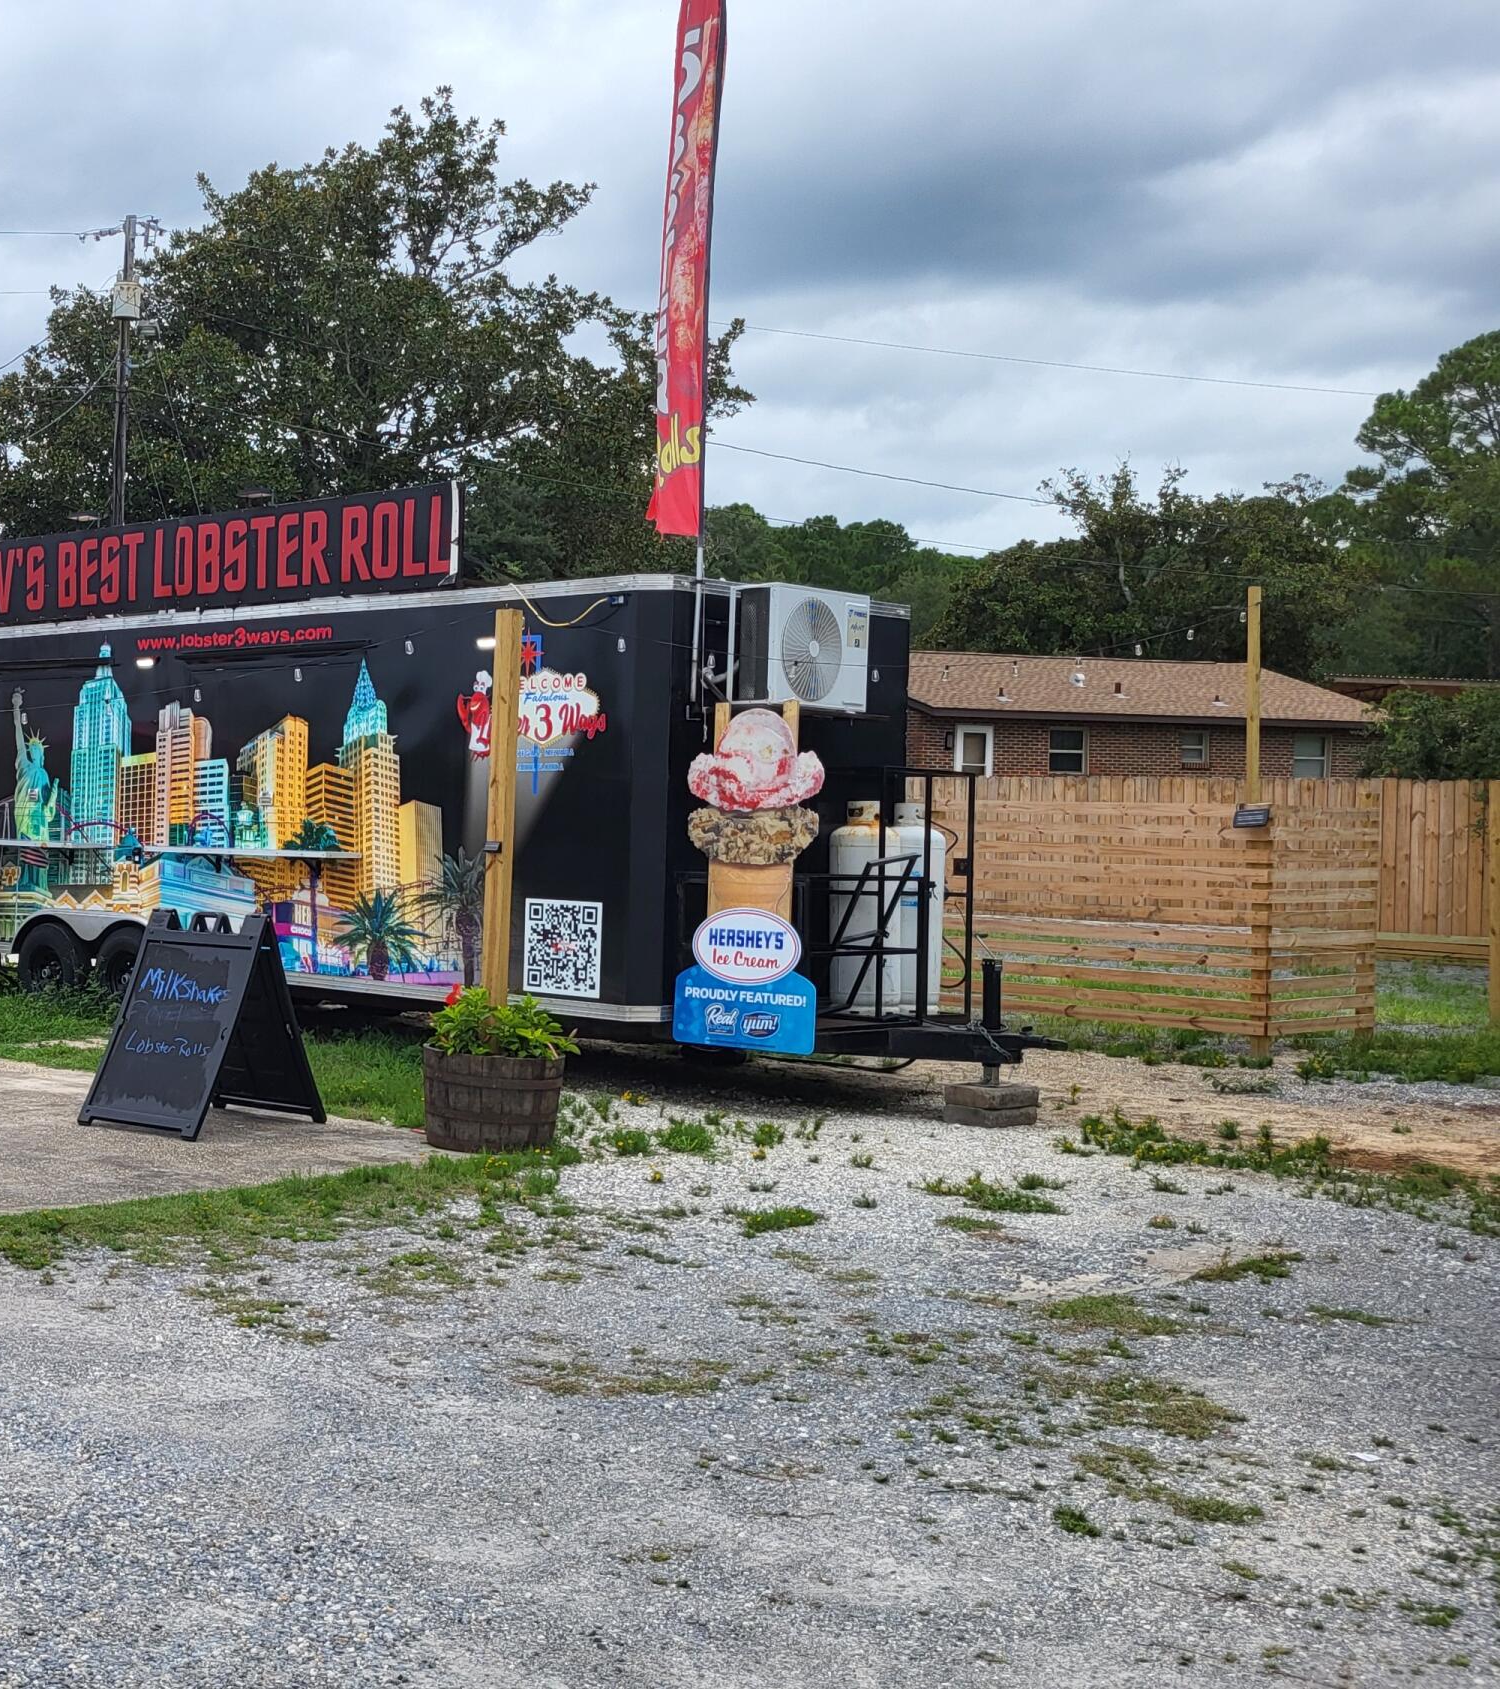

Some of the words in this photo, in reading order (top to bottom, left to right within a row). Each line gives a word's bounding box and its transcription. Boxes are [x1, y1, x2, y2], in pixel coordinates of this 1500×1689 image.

[58, 532, 145, 608] BEST
[153, 509, 331, 598] LOBSTER
[340, 494, 451, 583] ROLL
[137, 626, 333, 650] www.lobster3ways.com
[519, 676, 584, 690] ELCOME
[558, 702, 607, 740] Ways
[708, 927, 784, 950] HERSHEY'S
[712, 947, 731, 964] Ice
[733, 951, 780, 969] Cream
[684, 986, 739, 1002] PROUDLY
[739, 990, 807, 1008] FEATURED!
[706, 1004, 737, 1026] Real
[743, 1014, 779, 1034] yum!
[125, 1030, 176, 1054] Lobster
[173, 1037, 211, 1057] Rolls
